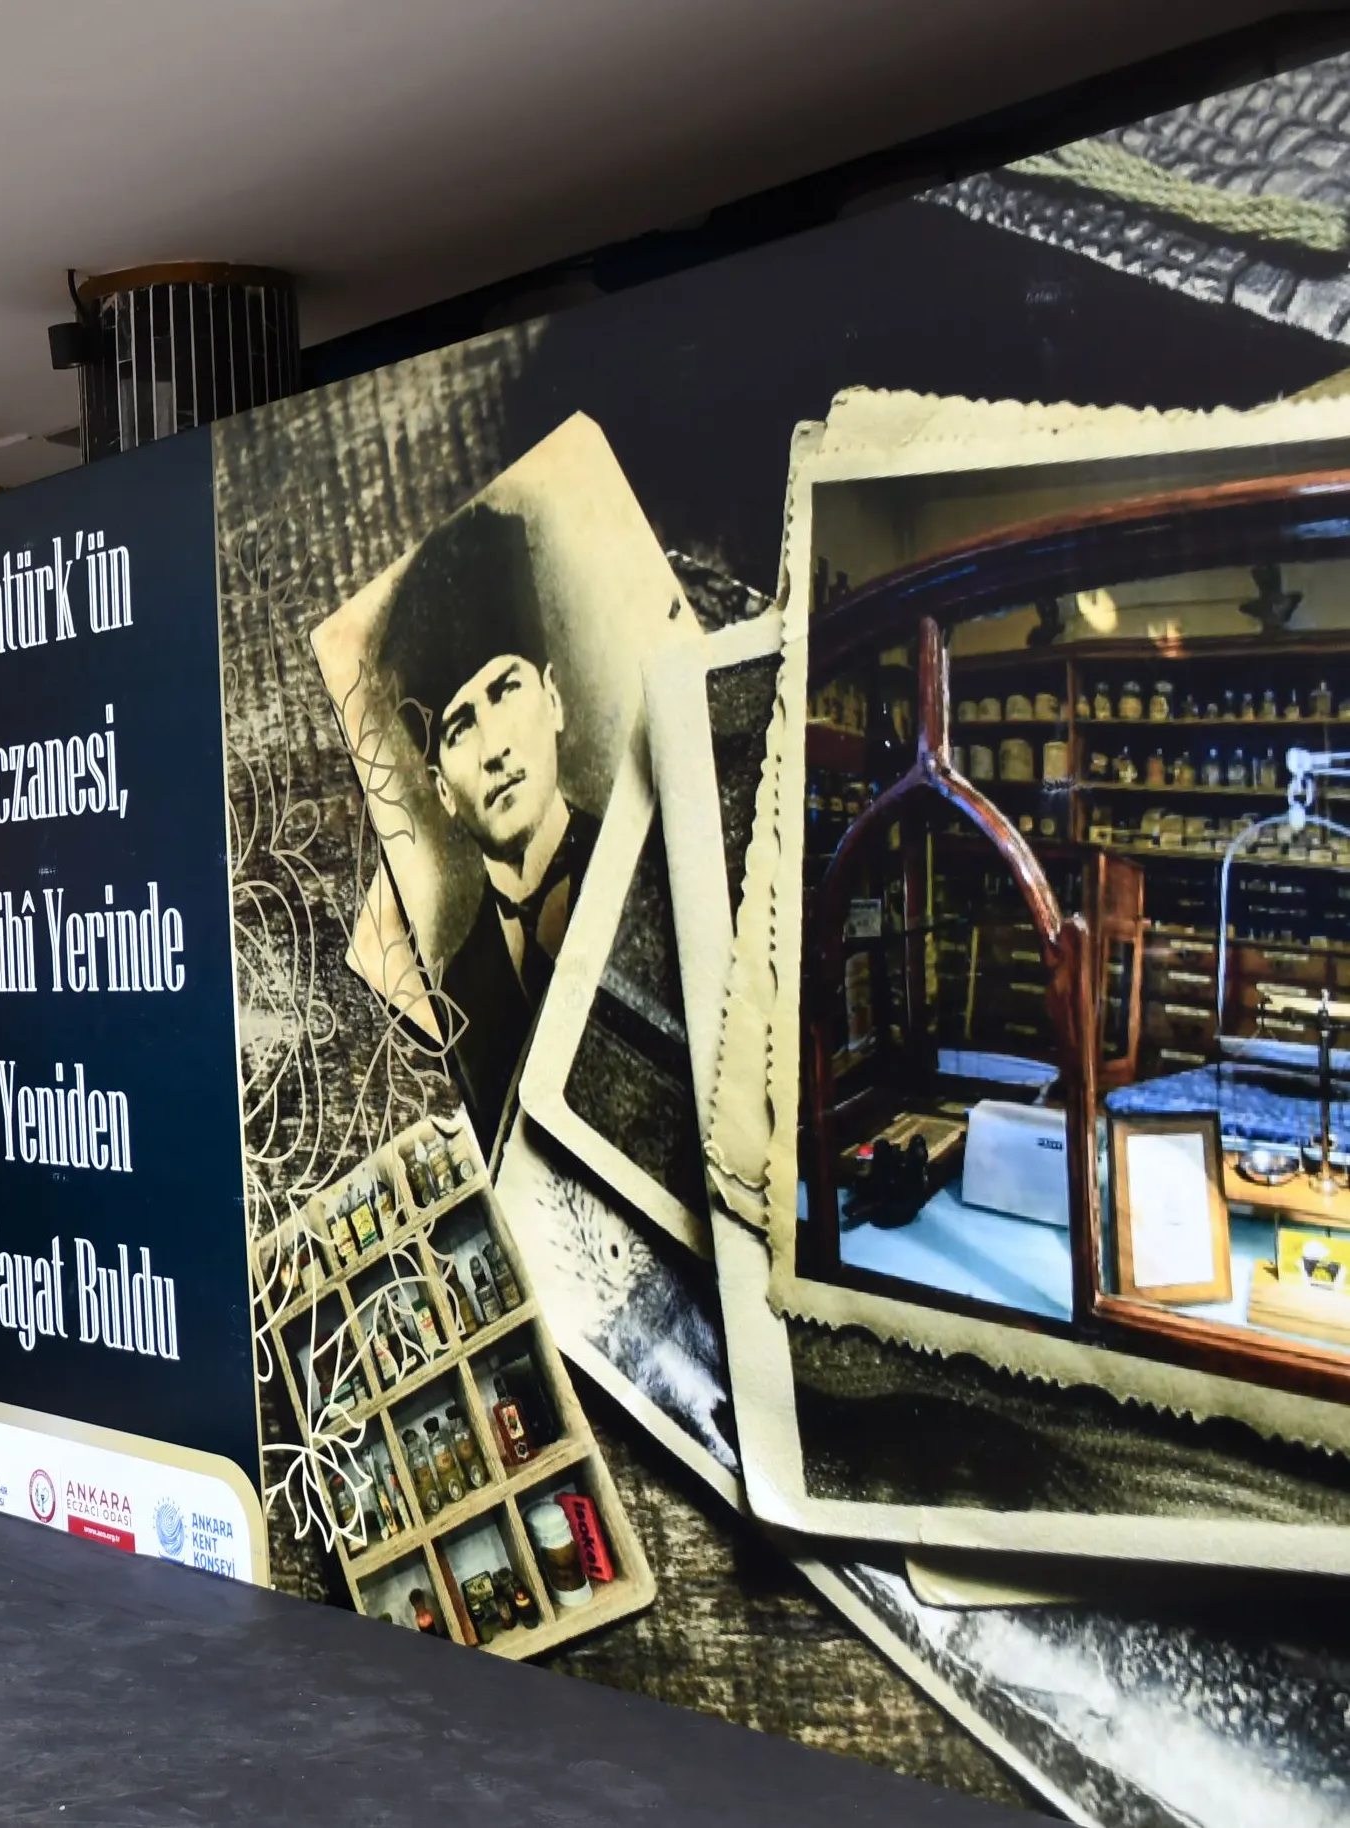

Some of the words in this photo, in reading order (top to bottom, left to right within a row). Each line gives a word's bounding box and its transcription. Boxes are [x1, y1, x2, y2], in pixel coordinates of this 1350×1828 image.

[43, 882, 185, 992] Yerinde
[74, 1237, 181, 1362] Buldu
[66, 1479, 132, 1515] ANKARA
[66, 1498, 100, 1518] ECZACI
[102, 1509, 133, 1528] ODASI
[191, 1512, 234, 1540] ANKARA
[191, 1531, 218, 1554] KENT
